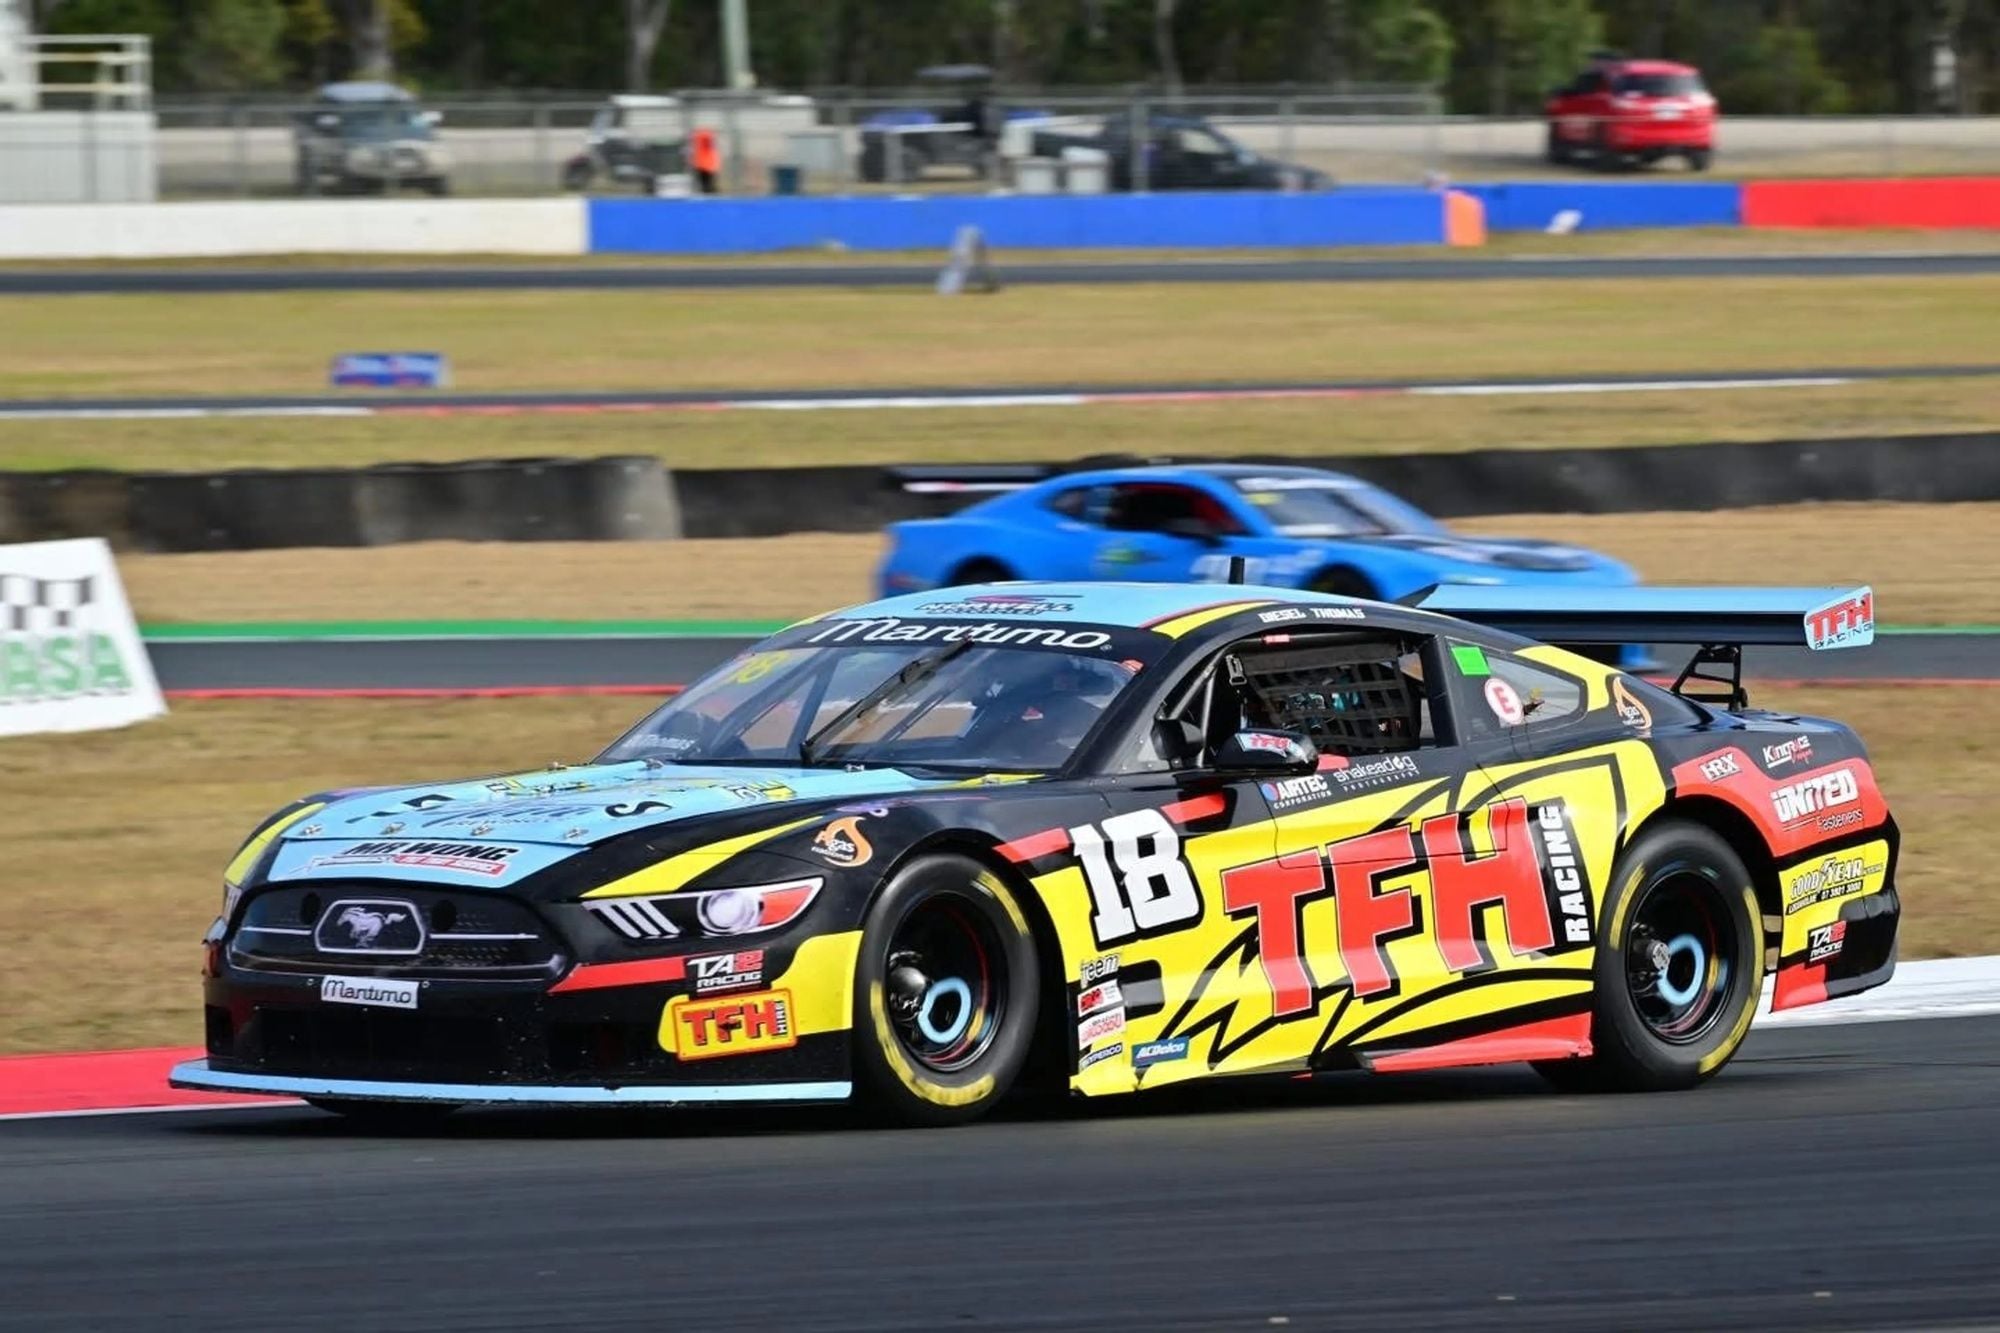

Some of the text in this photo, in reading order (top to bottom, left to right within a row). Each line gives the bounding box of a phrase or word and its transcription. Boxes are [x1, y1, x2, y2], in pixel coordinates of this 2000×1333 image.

[1258, 608, 1366, 623] DIESEL THOMAS
[1806, 592, 1871, 643] TFH
[1814, 623, 1872, 650] RACING
[1273, 789, 1332, 810] CORPORATION
[1276, 774, 1329, 800] AIRTEC
[401, 842, 519, 861] WONG
[1070, 808, 1200, 943] 18
[1538, 805, 1590, 942] RACING
[1221, 798, 1556, 1018] TFH
[1810, 921, 1847, 949] TA2
[687, 950, 764, 978] TA2
[696, 971, 763, 988] RACING
[682, 1000, 778, 1046] TFH
[1135, 1042, 1186, 1059] ACDelco
